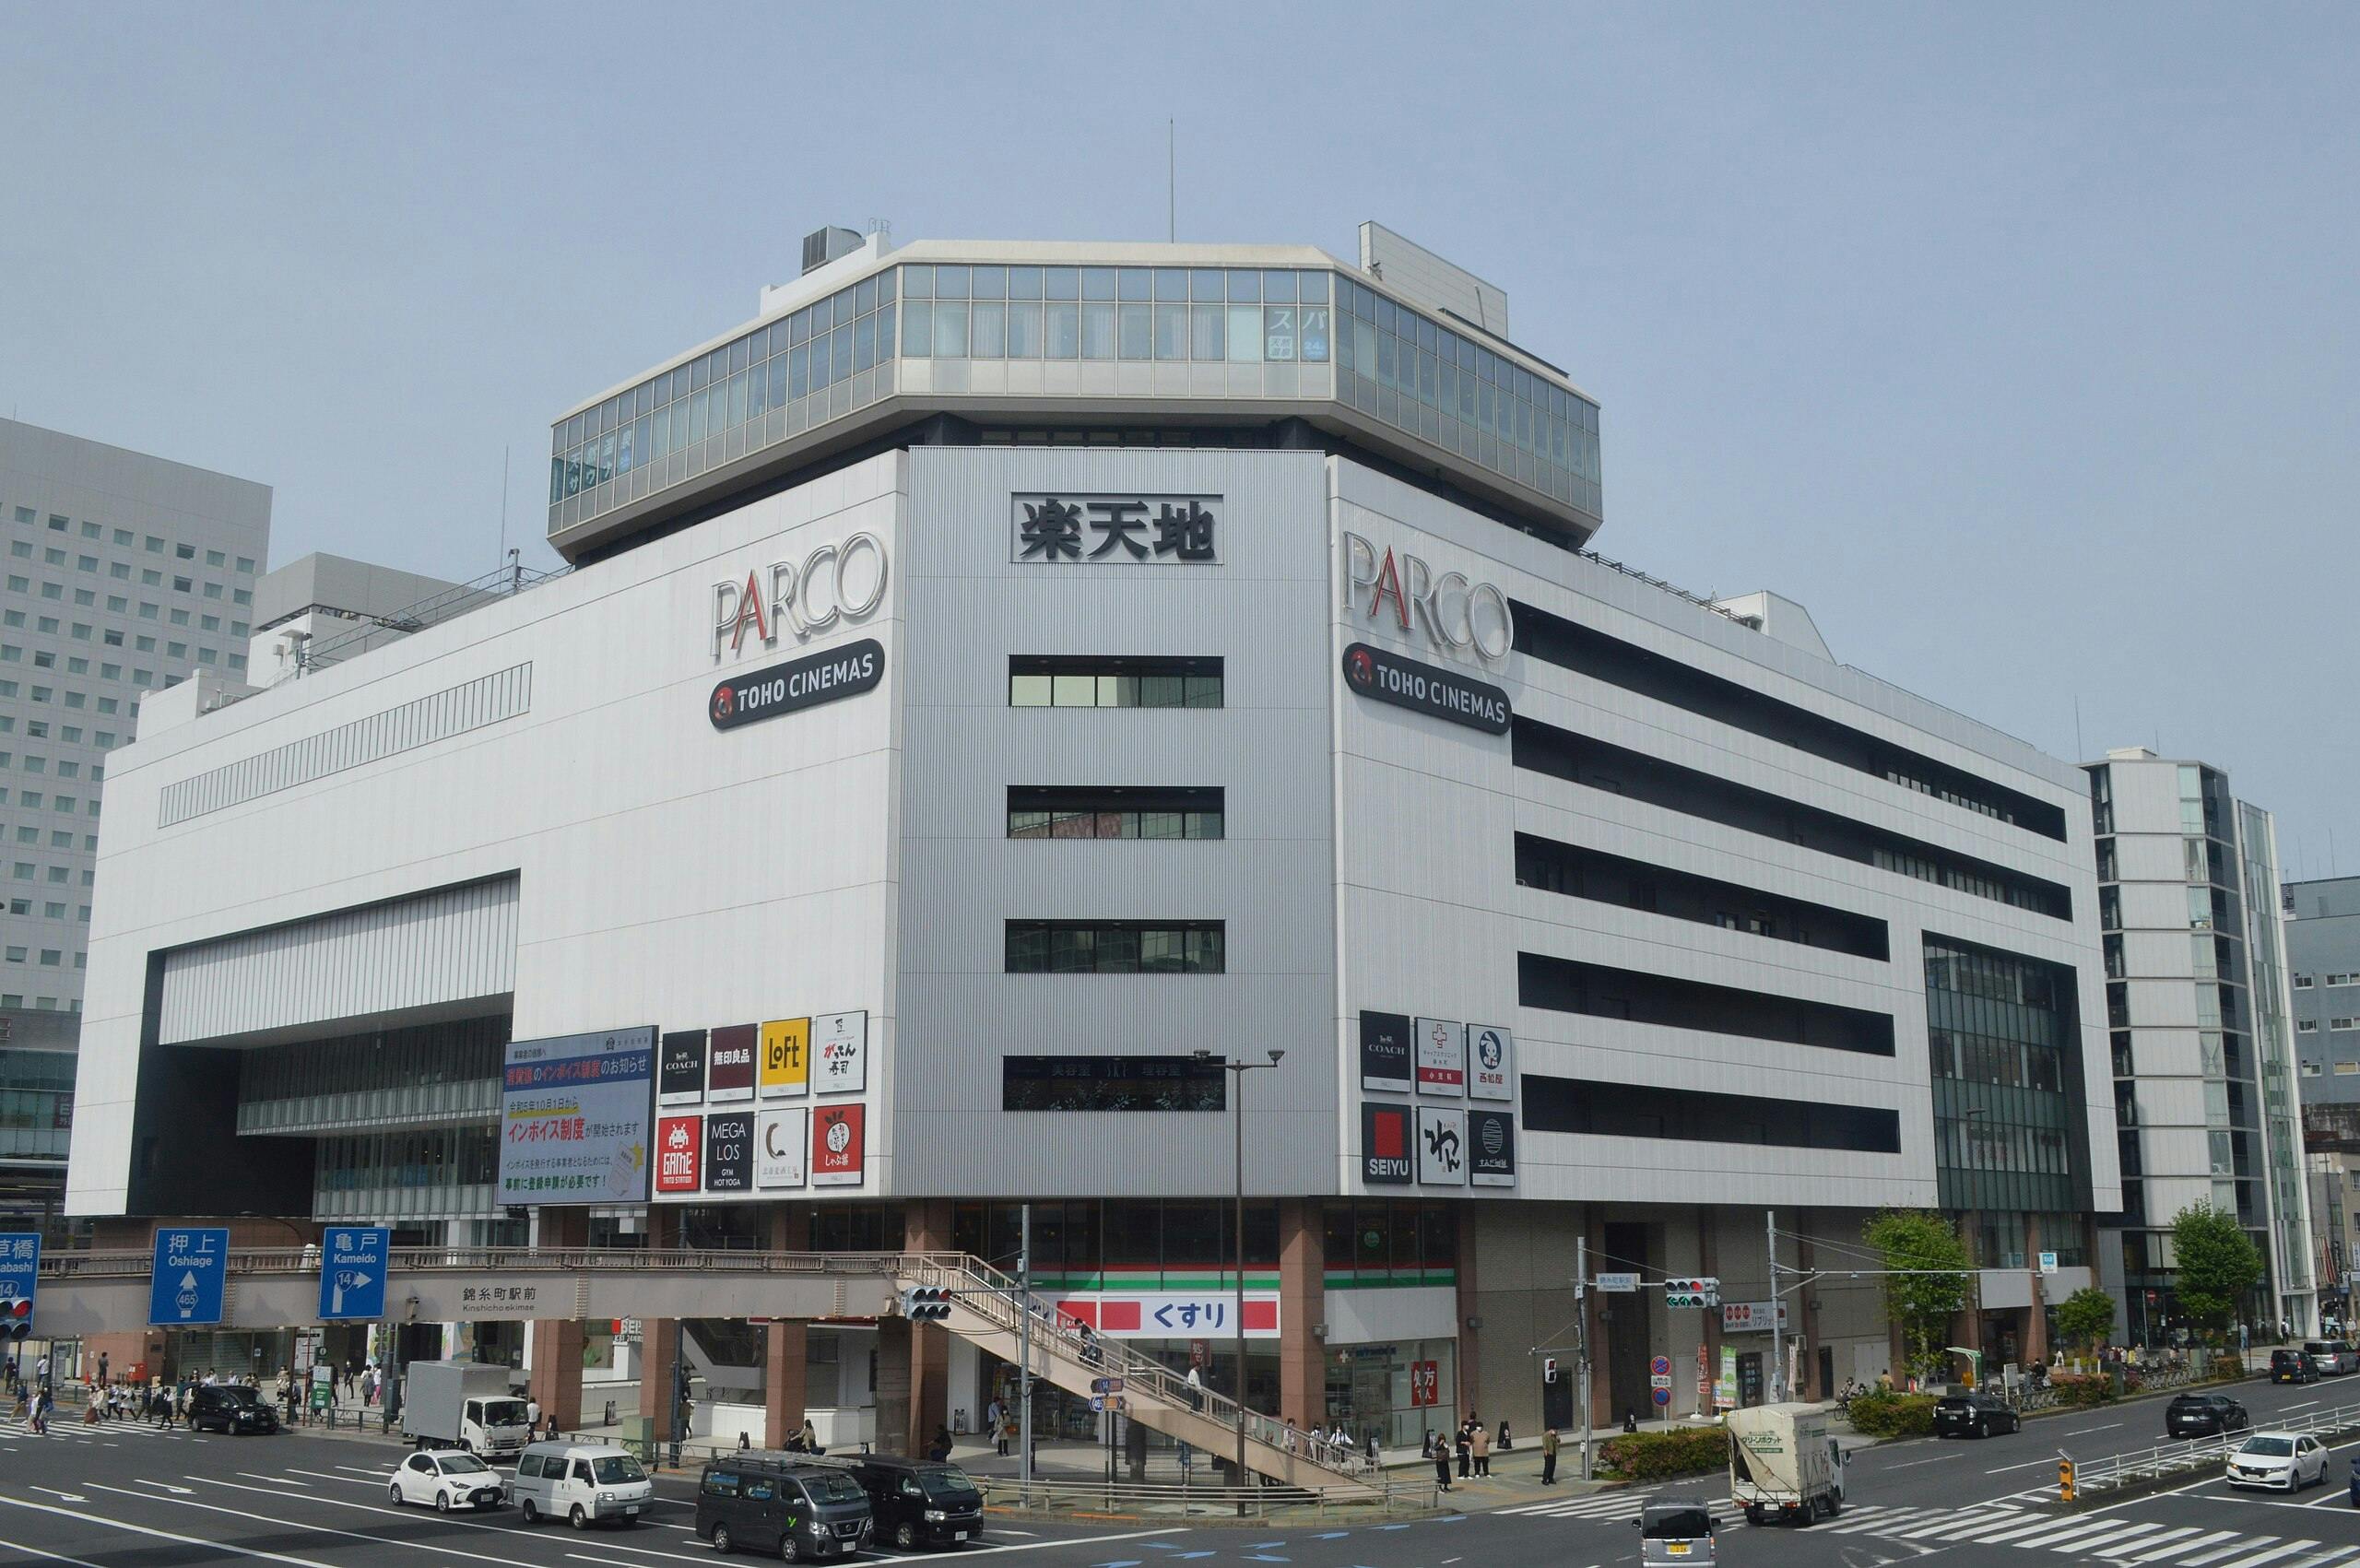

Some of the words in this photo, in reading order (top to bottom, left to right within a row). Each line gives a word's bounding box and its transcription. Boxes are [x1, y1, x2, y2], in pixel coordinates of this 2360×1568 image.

[1268, 311, 1328, 330] スパ
[1020, 498, 1215, 560] 楽天地
[710, 531, 889, 656] PARCO
[1343, 531, 1514, 660] PARCO
[738, 678, 784, 712] TOHO
[789, 654, 873, 697] CINEMAS
[1377, 664, 1426, 700] TOHO
[1430, 681, 1505, 724] CINEMAS
[714, 1048, 750, 1066] 無印良品
[823, 1043, 856, 1059] がってん
[1368, 1043, 1405, 1055] COACH
[666, 1060, 698, 1070] COACH
[829, 1060, 849, 1076] 寿司
[1480, 1072, 1504, 1085] 西松屋
[712, 1122, 746, 1139] MEGA
[716, 1144, 739, 1161] LOS
[1423, 1118, 1460, 1173] わん
[663, 1151, 692, 1175] GAME
[1369, 1158, 1409, 1176] SEIYU
[721, 1168, 734, 1176] GYM
[725, 1178, 740, 1186] YOGA
[169, 1234, 215, 1254] 押上
[336, 1233, 378, 1251] 亀戸
[169, 1256, 213, 1267] Oshiage
[334, 1253, 377, 1264] Kameido
[338, 1273, 351, 1285] 14
[179, 1294, 195, 1305] 465
[463, 1287, 537, 1302] 錦糸町駅前
[463, 1303, 504, 1312] Kinshicho
[504, 1303, 535, 1312] ekimae
[1154, 1303, 1224, 1329] くすり
